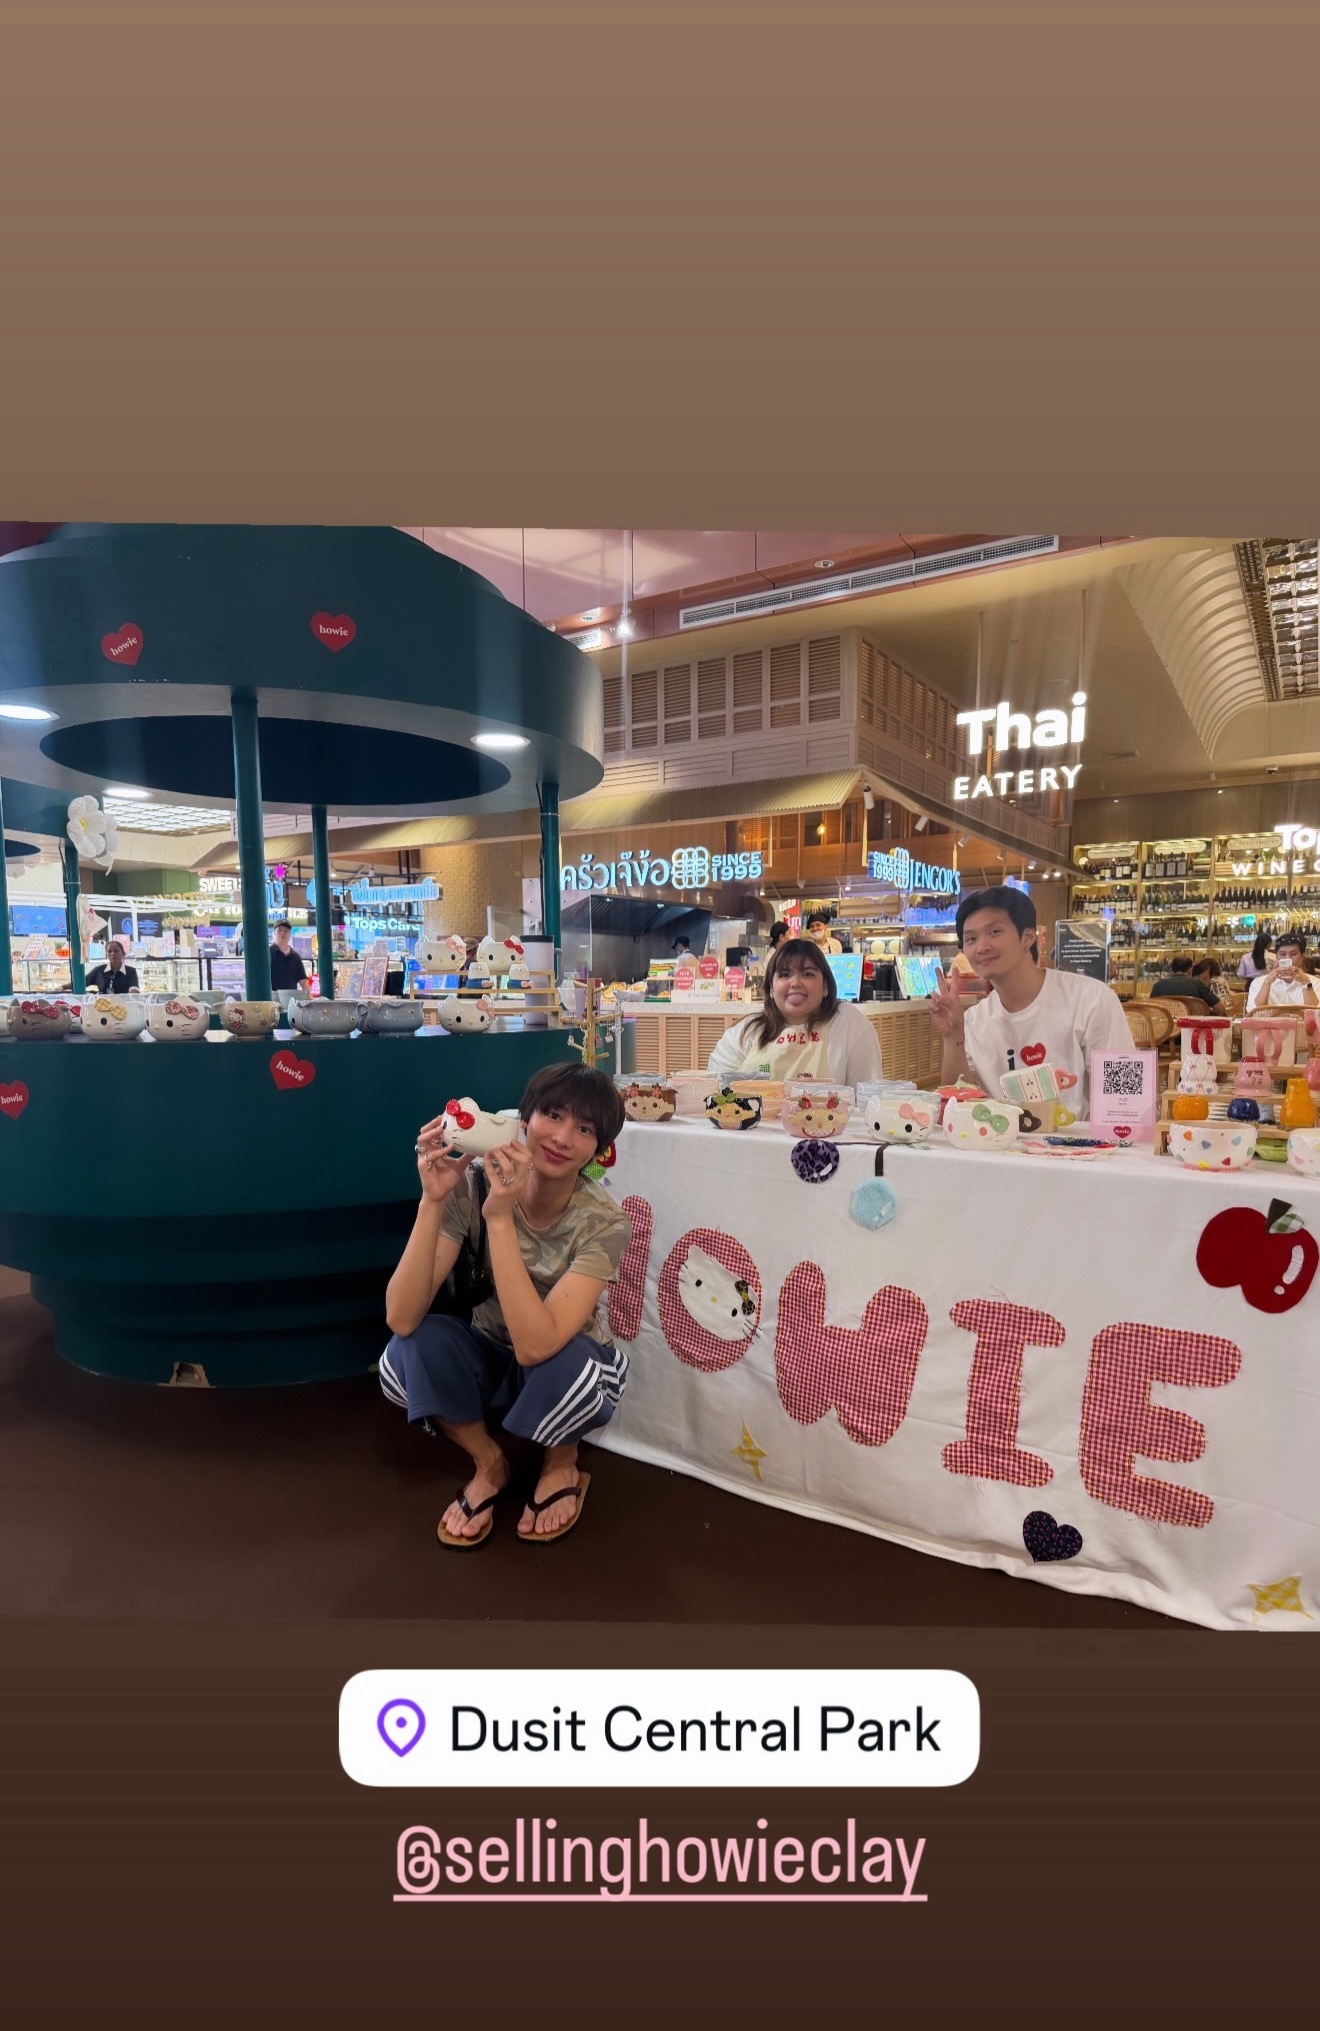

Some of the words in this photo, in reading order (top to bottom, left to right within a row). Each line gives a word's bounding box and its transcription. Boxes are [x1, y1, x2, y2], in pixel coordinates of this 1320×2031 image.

[319, 624, 349, 636] howie
[110, 636, 138, 656] howie
[956, 691, 1087, 755] Thai
[954, 764, 1083, 800] EATERY
[712, 851, 762, 867] SINCE
[873, 851, 894, 866] SINCE
[1232, 859, 1306, 876] WINE
[712, 863, 762, 882] 1999
[873, 864, 894, 882] 1999
[908, 858, 961, 895] JENGOR'S
[354, 915, 387, 932] Tops
[1007, 1048, 1016, 1071] i
[276, 1060, 305, 1081] howie
[0, 1093, 23, 1104] howie
